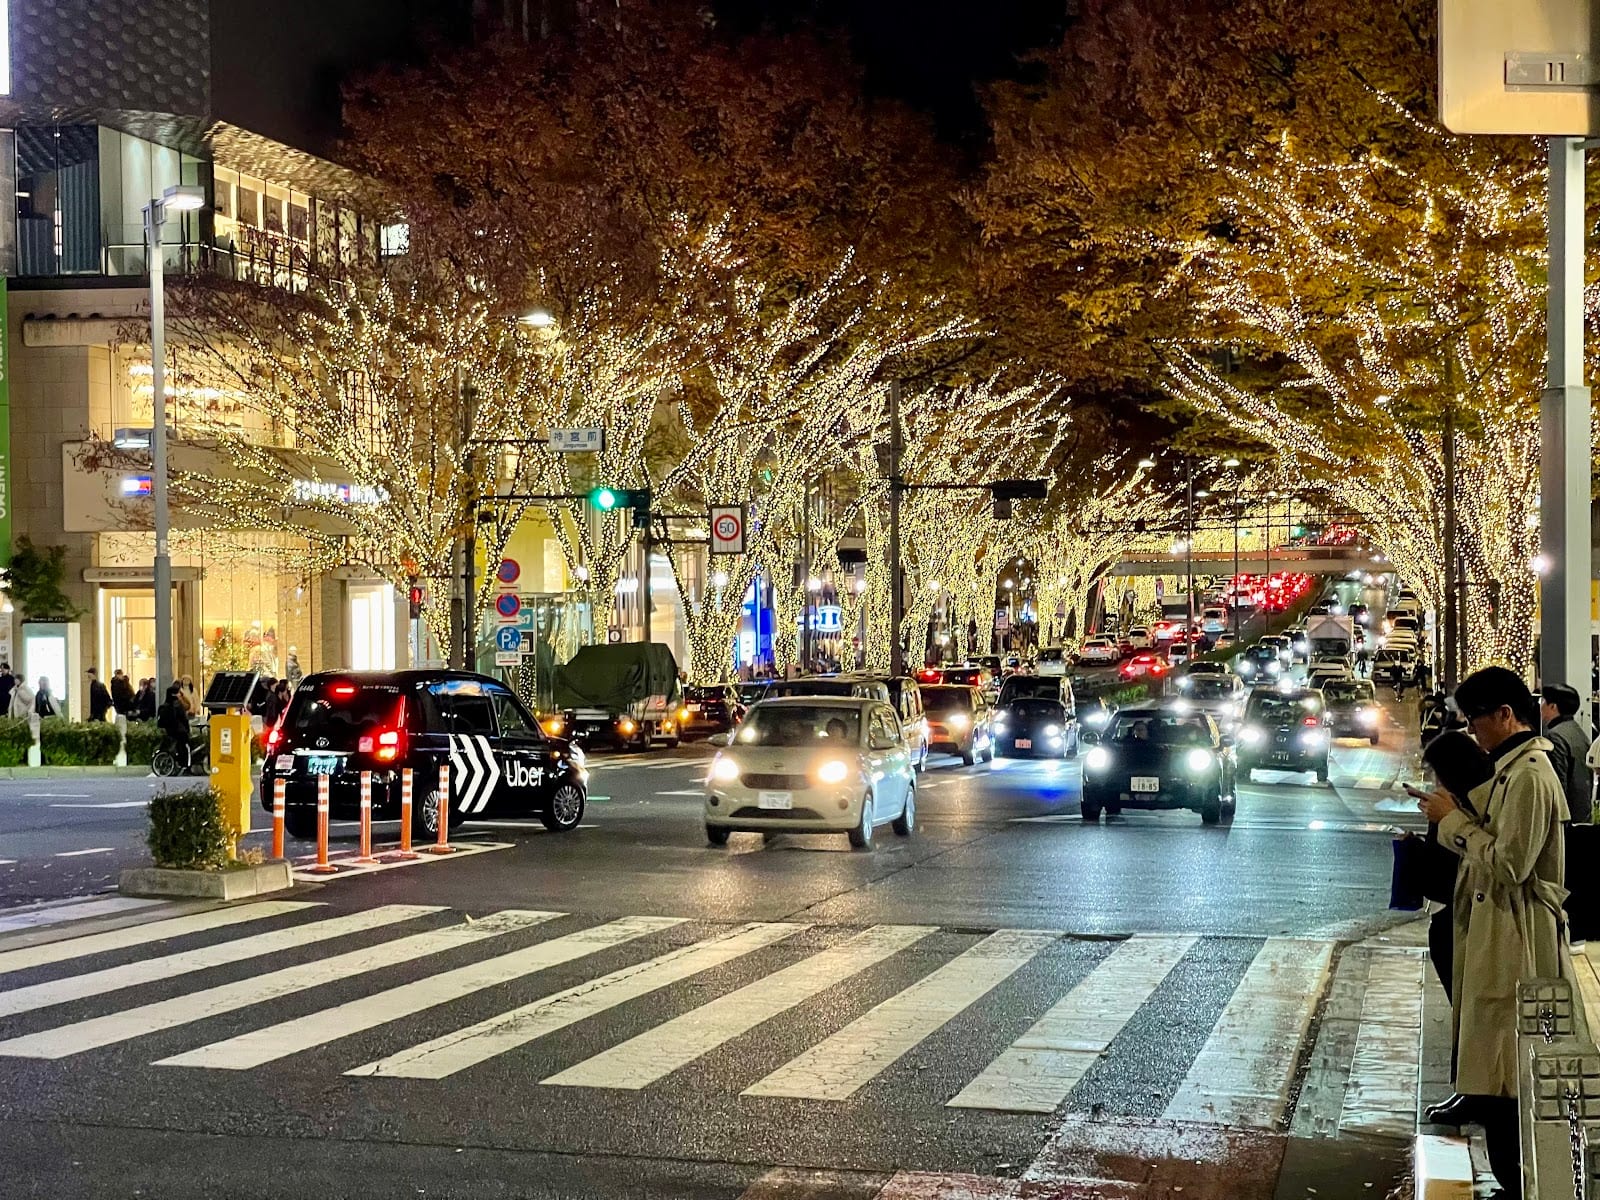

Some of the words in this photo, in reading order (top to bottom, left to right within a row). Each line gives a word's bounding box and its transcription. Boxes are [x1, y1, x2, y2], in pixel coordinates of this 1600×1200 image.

[553, 431, 597, 441] 神宮前
[719, 522, 735, 534] 50
[501, 632, 512, 649] P
[505, 760, 543, 787] Uber
